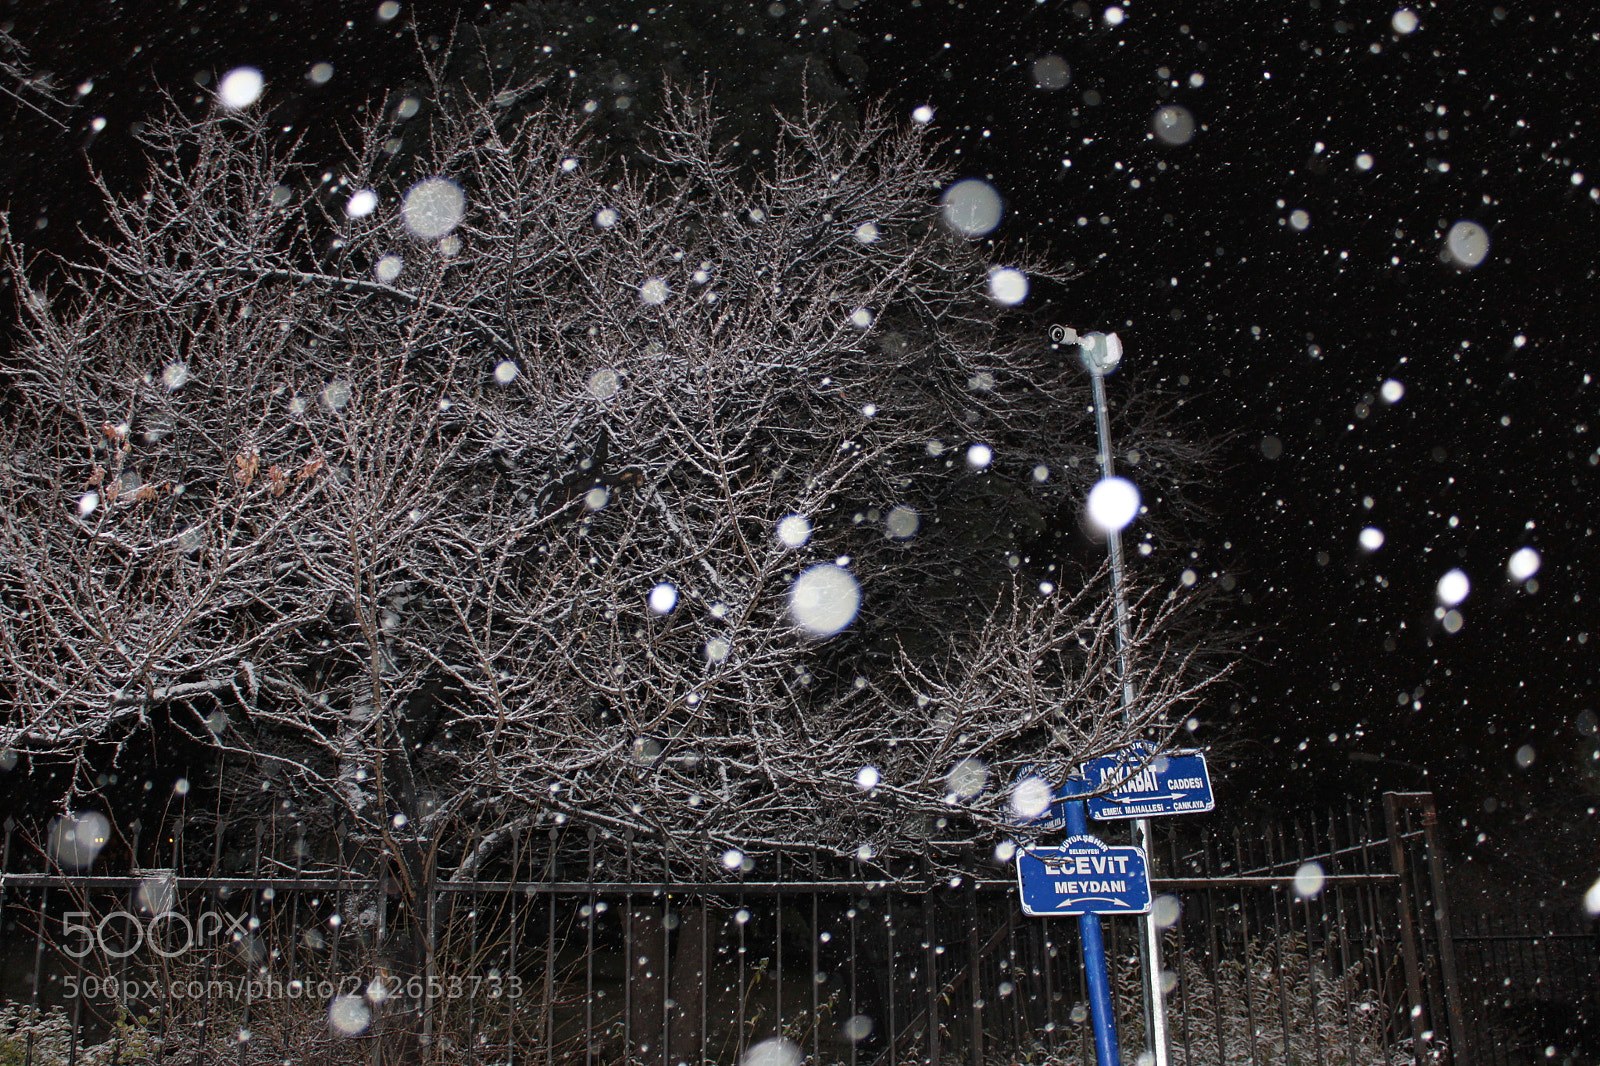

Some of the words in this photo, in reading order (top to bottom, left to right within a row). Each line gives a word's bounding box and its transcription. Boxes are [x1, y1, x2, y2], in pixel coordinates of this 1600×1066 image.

[1102, 806, 1123, 816] EMEK
[1173, 800, 1205, 812] ÇANKAYA
[1054, 880, 1127, 894] MEYDANI
